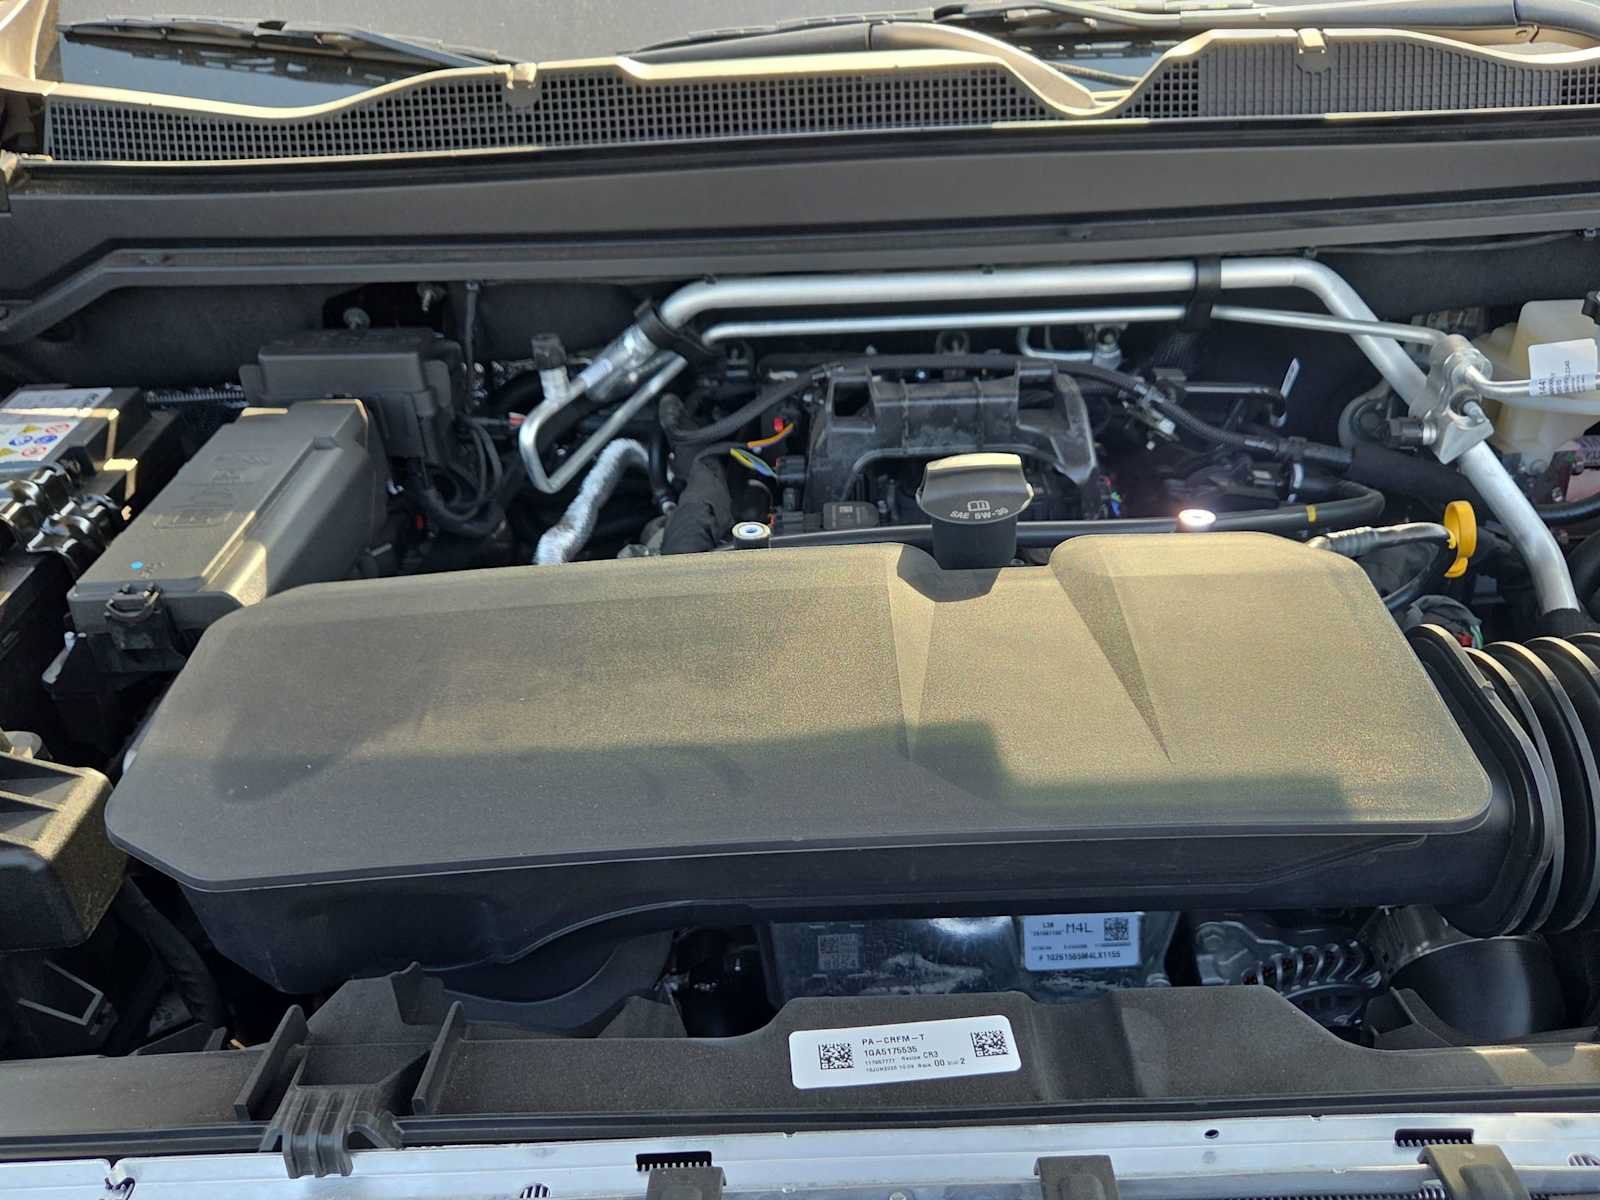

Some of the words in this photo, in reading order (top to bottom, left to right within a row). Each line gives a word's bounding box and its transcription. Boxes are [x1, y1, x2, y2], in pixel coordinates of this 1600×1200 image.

[950, 510, 969, 519] SAE
[1066, 922, 1094, 934] M4L
[934, 1059, 945, 1067] 00
[959, 1057, 966, 1065] 2
